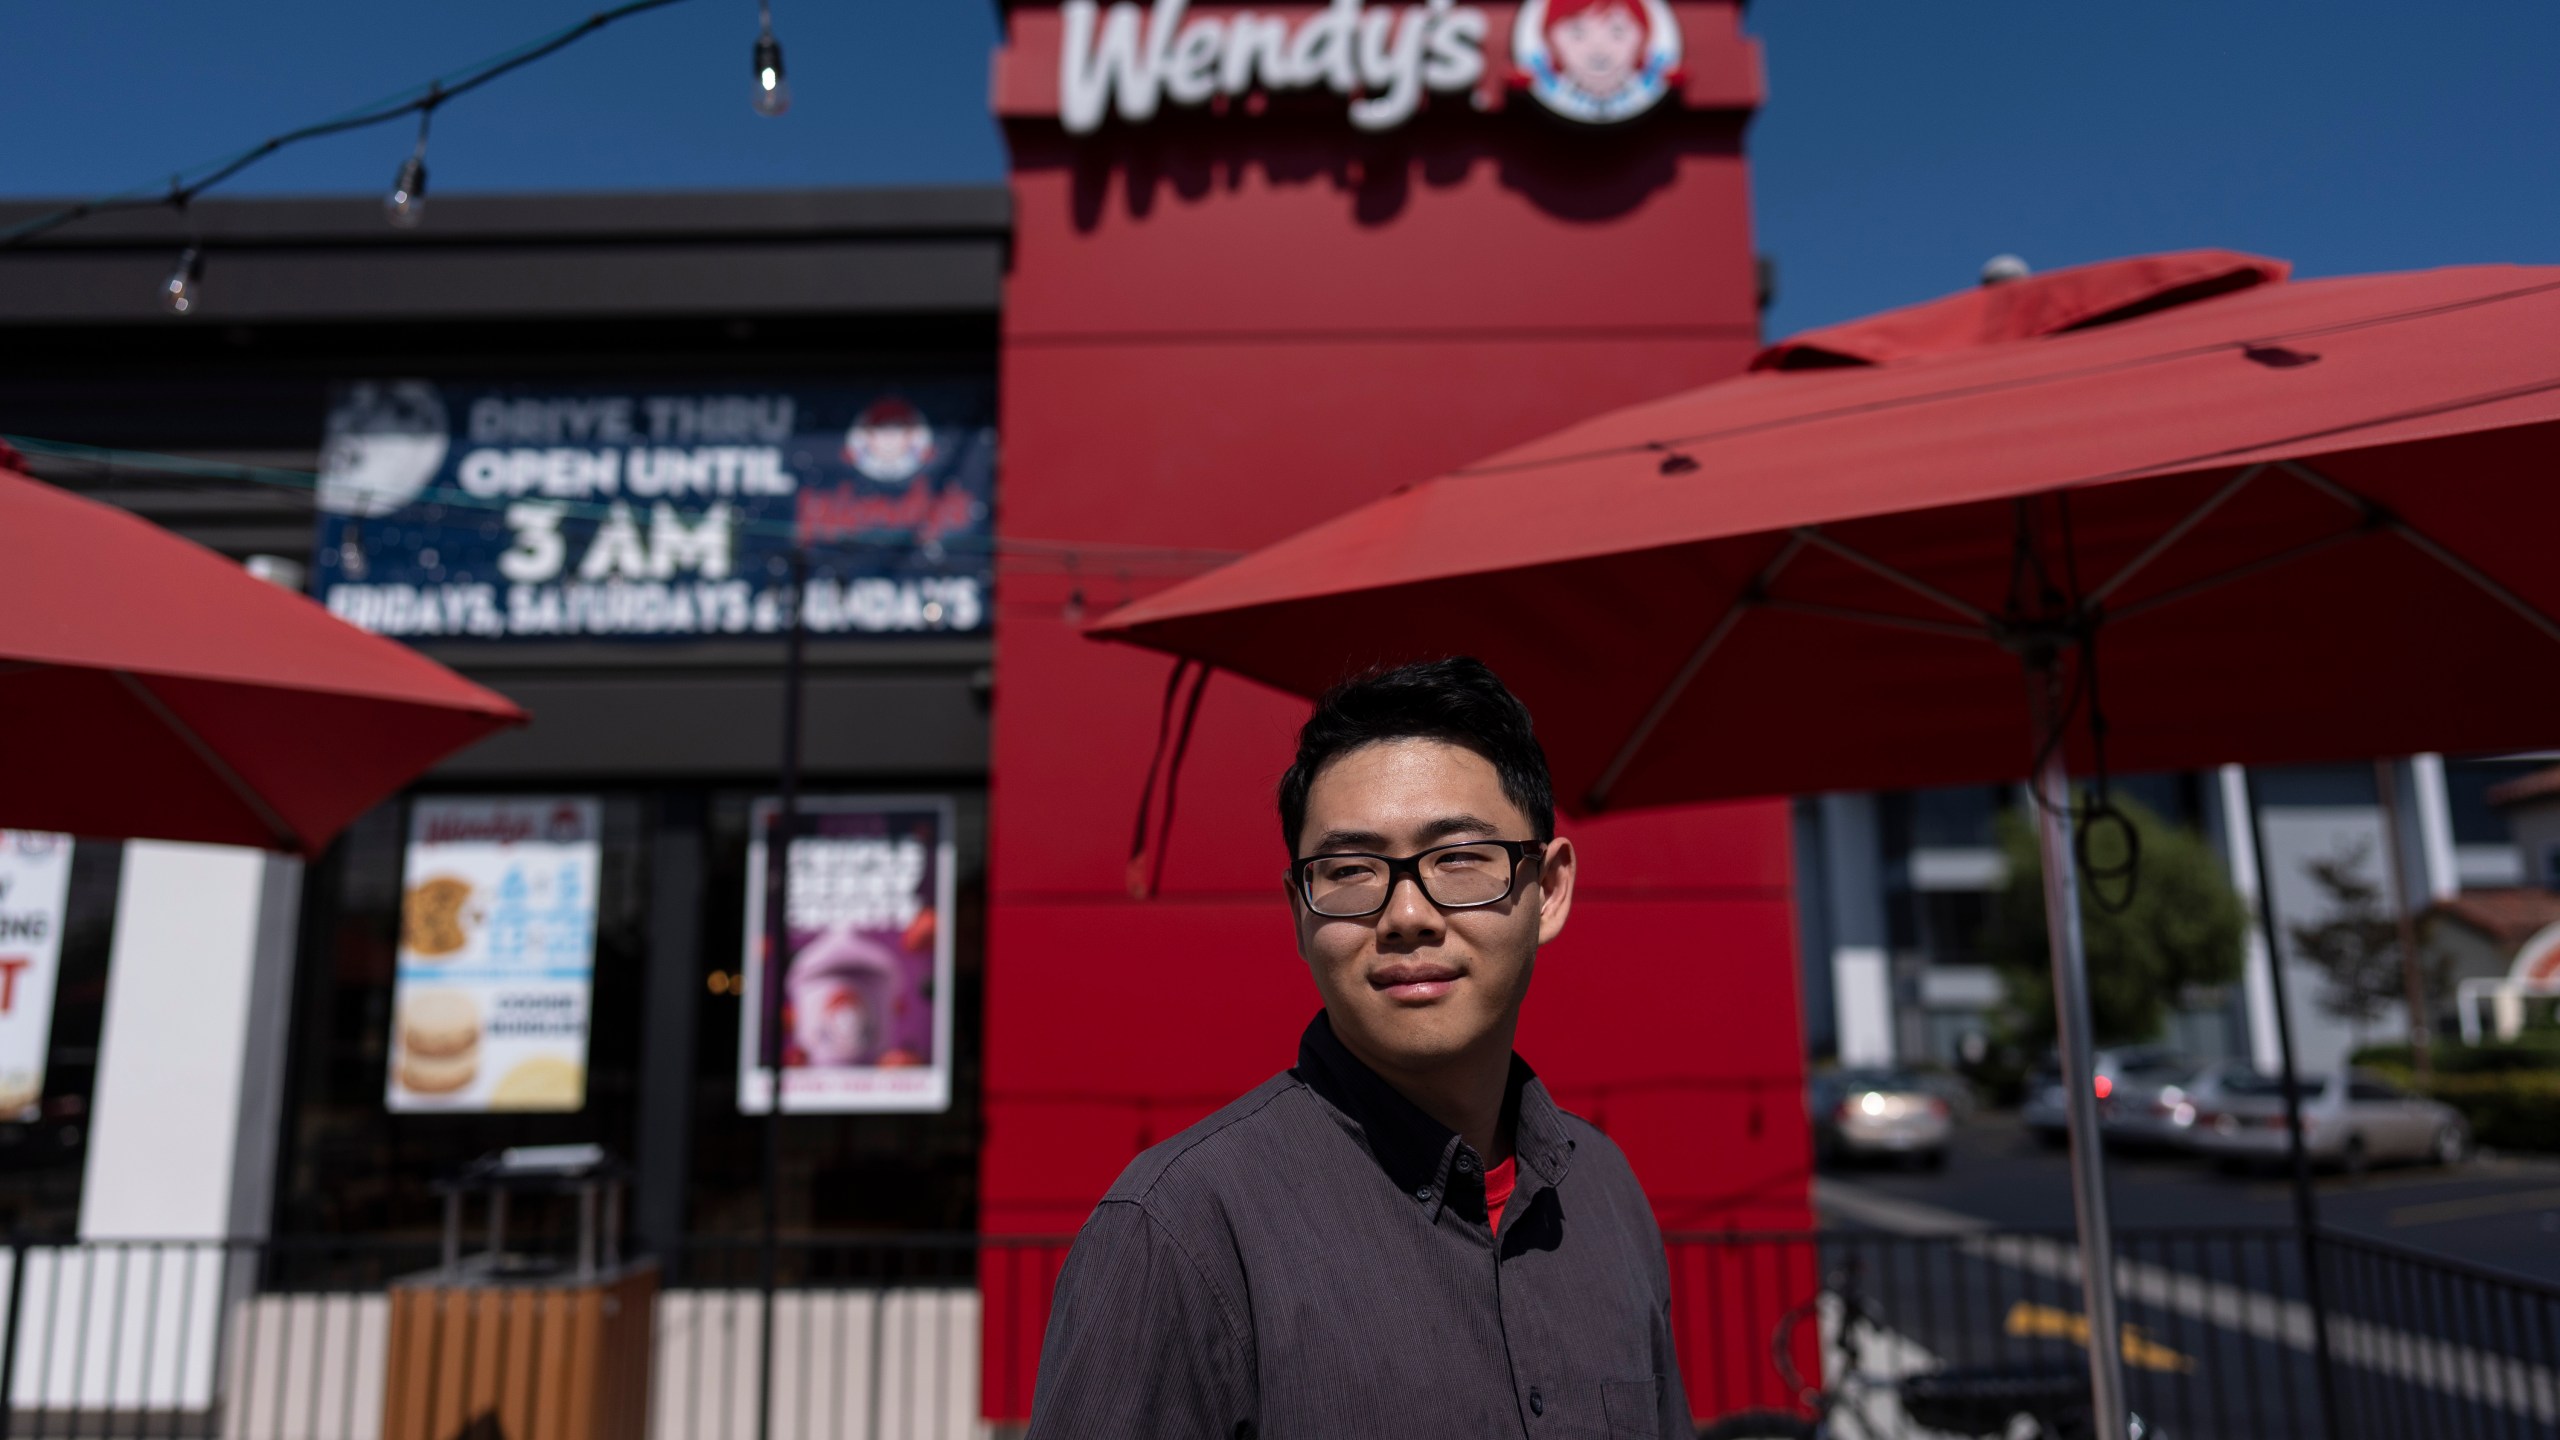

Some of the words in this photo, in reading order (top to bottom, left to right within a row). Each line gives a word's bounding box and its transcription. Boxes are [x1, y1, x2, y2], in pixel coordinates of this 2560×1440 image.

[1058, 0, 1488, 132] Wendy's
[469, 396, 633, 441] DRIVE
[647, 396, 796, 439] THRU
[458, 447, 618, 497] OPEN
[624, 446, 797, 496] UNTIL
[499, 501, 565, 583] 3
[578, 500, 732, 582] AM
[507, 580, 751, 634] SATURDAYS
